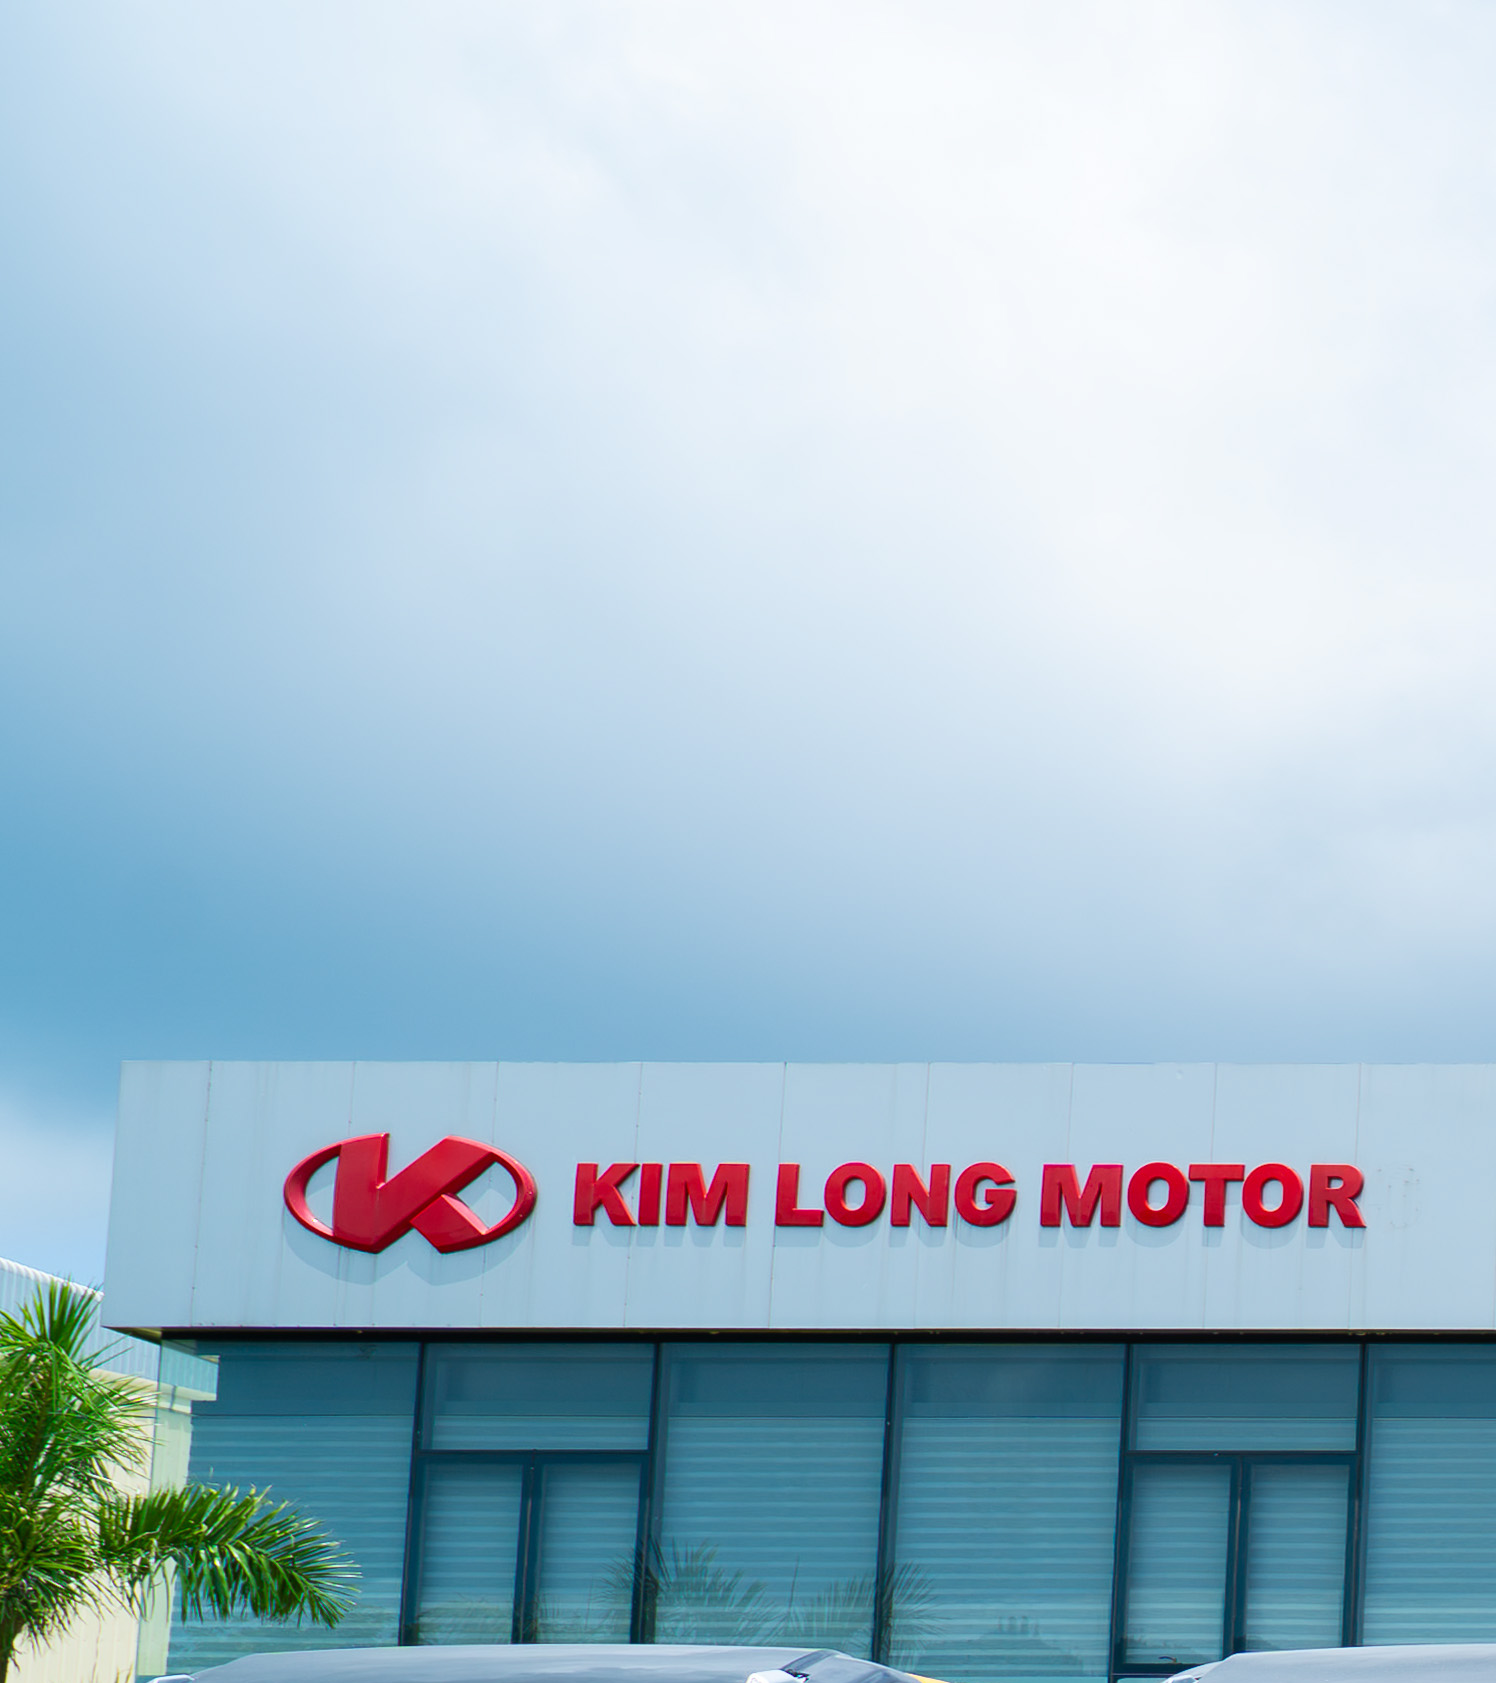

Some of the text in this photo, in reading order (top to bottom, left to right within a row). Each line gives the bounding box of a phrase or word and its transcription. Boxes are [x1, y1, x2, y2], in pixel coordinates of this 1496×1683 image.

[574, 1161, 1367, 1229] KIM LONG MOTOR
